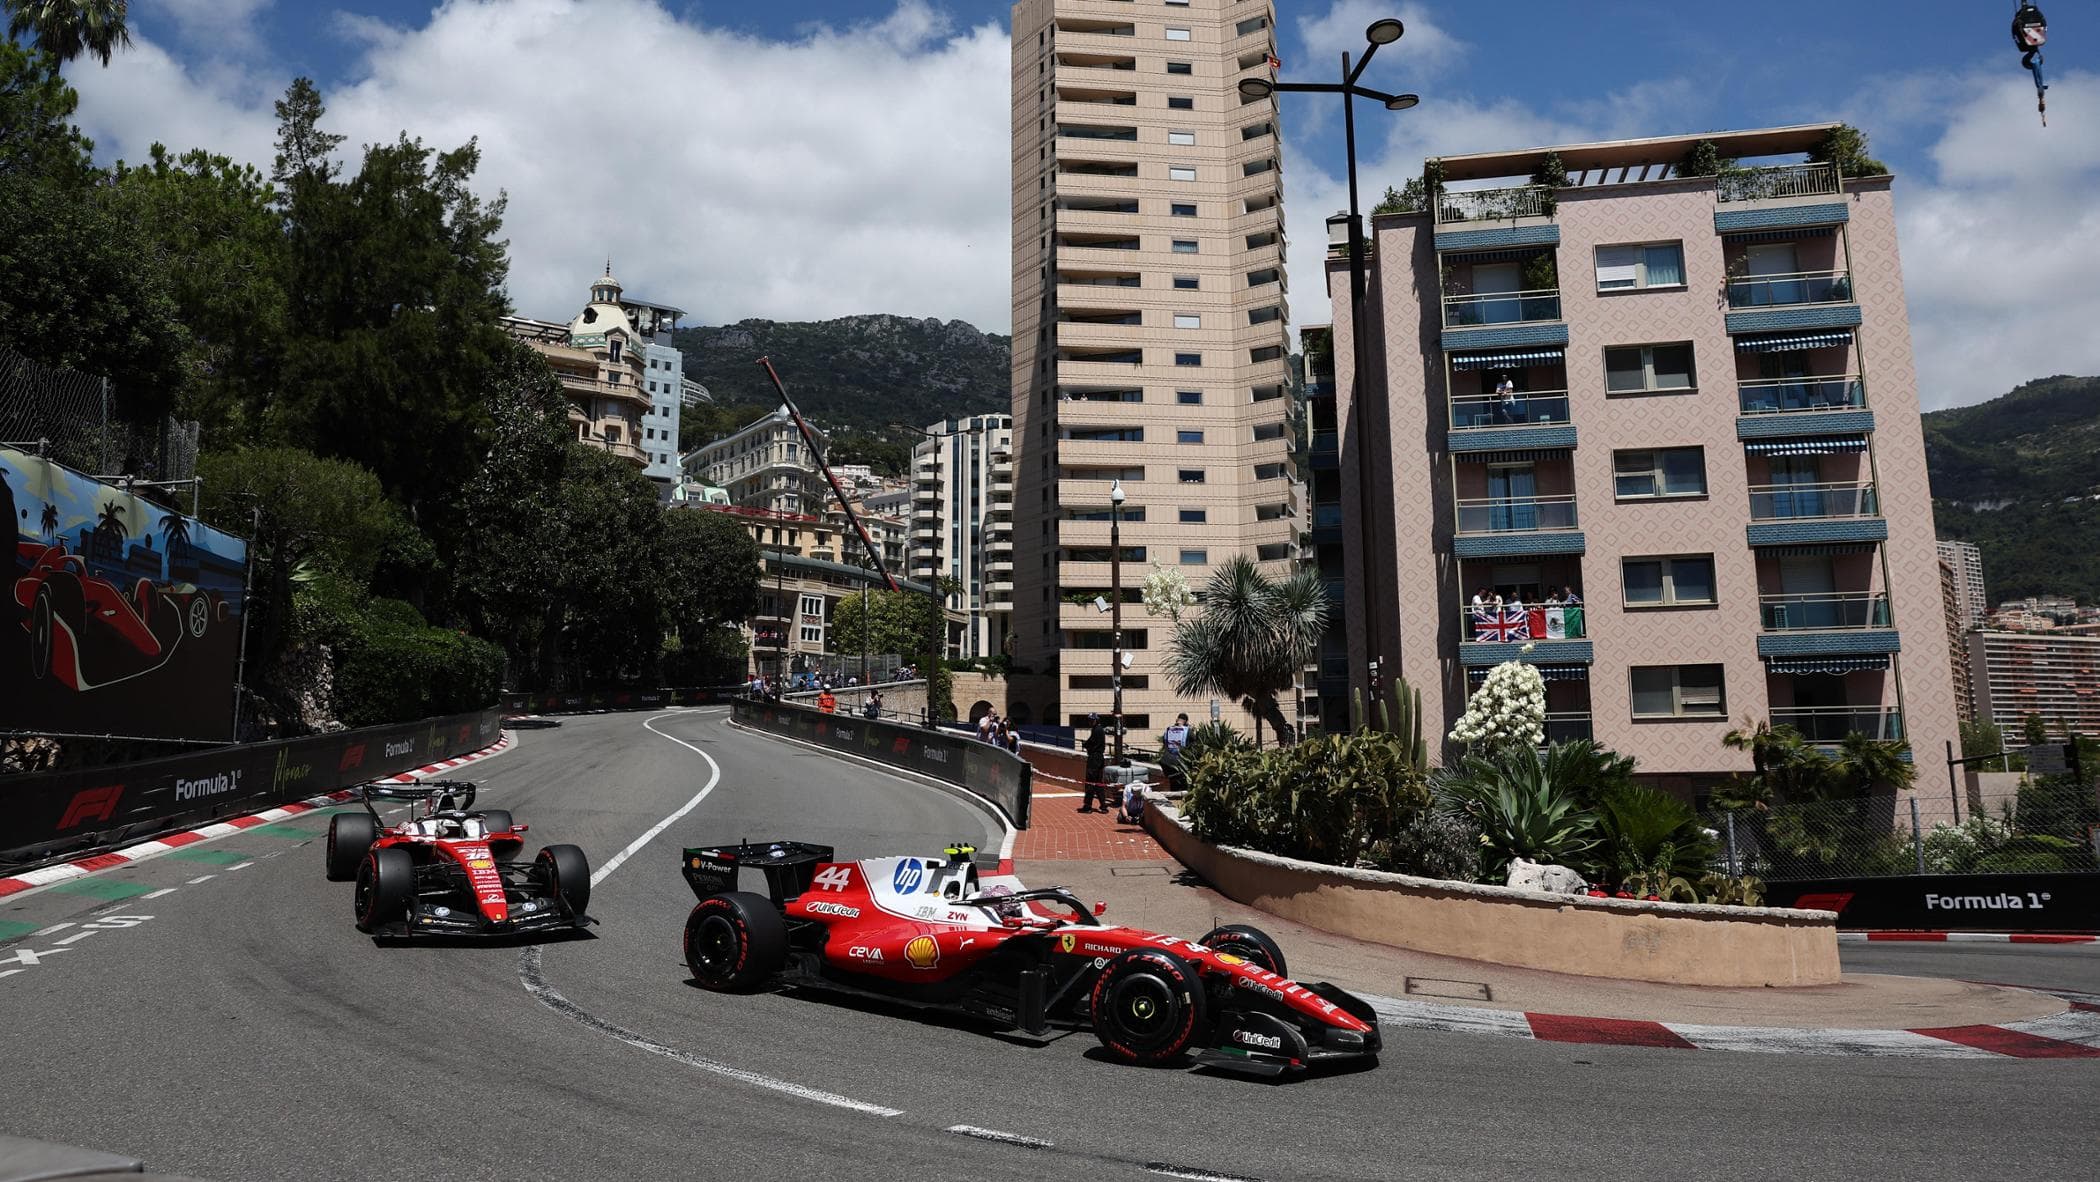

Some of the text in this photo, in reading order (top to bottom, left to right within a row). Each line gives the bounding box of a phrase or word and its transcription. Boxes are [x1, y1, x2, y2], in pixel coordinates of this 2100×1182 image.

[386, 739, 408, 758] Formula
[176, 772, 228, 801] Formula
[57, 784, 125, 830] F1
[701, 860, 732, 873] V-Power
[814, 866, 851, 892] 44
[893, 858, 922, 895] hp
[1926, 893, 2023, 910] Formula
[948, 911, 968, 921] ZYN
[1085, 943, 1121, 954] RICHARD
[1243, 1031, 1281, 1049] UniCredit
